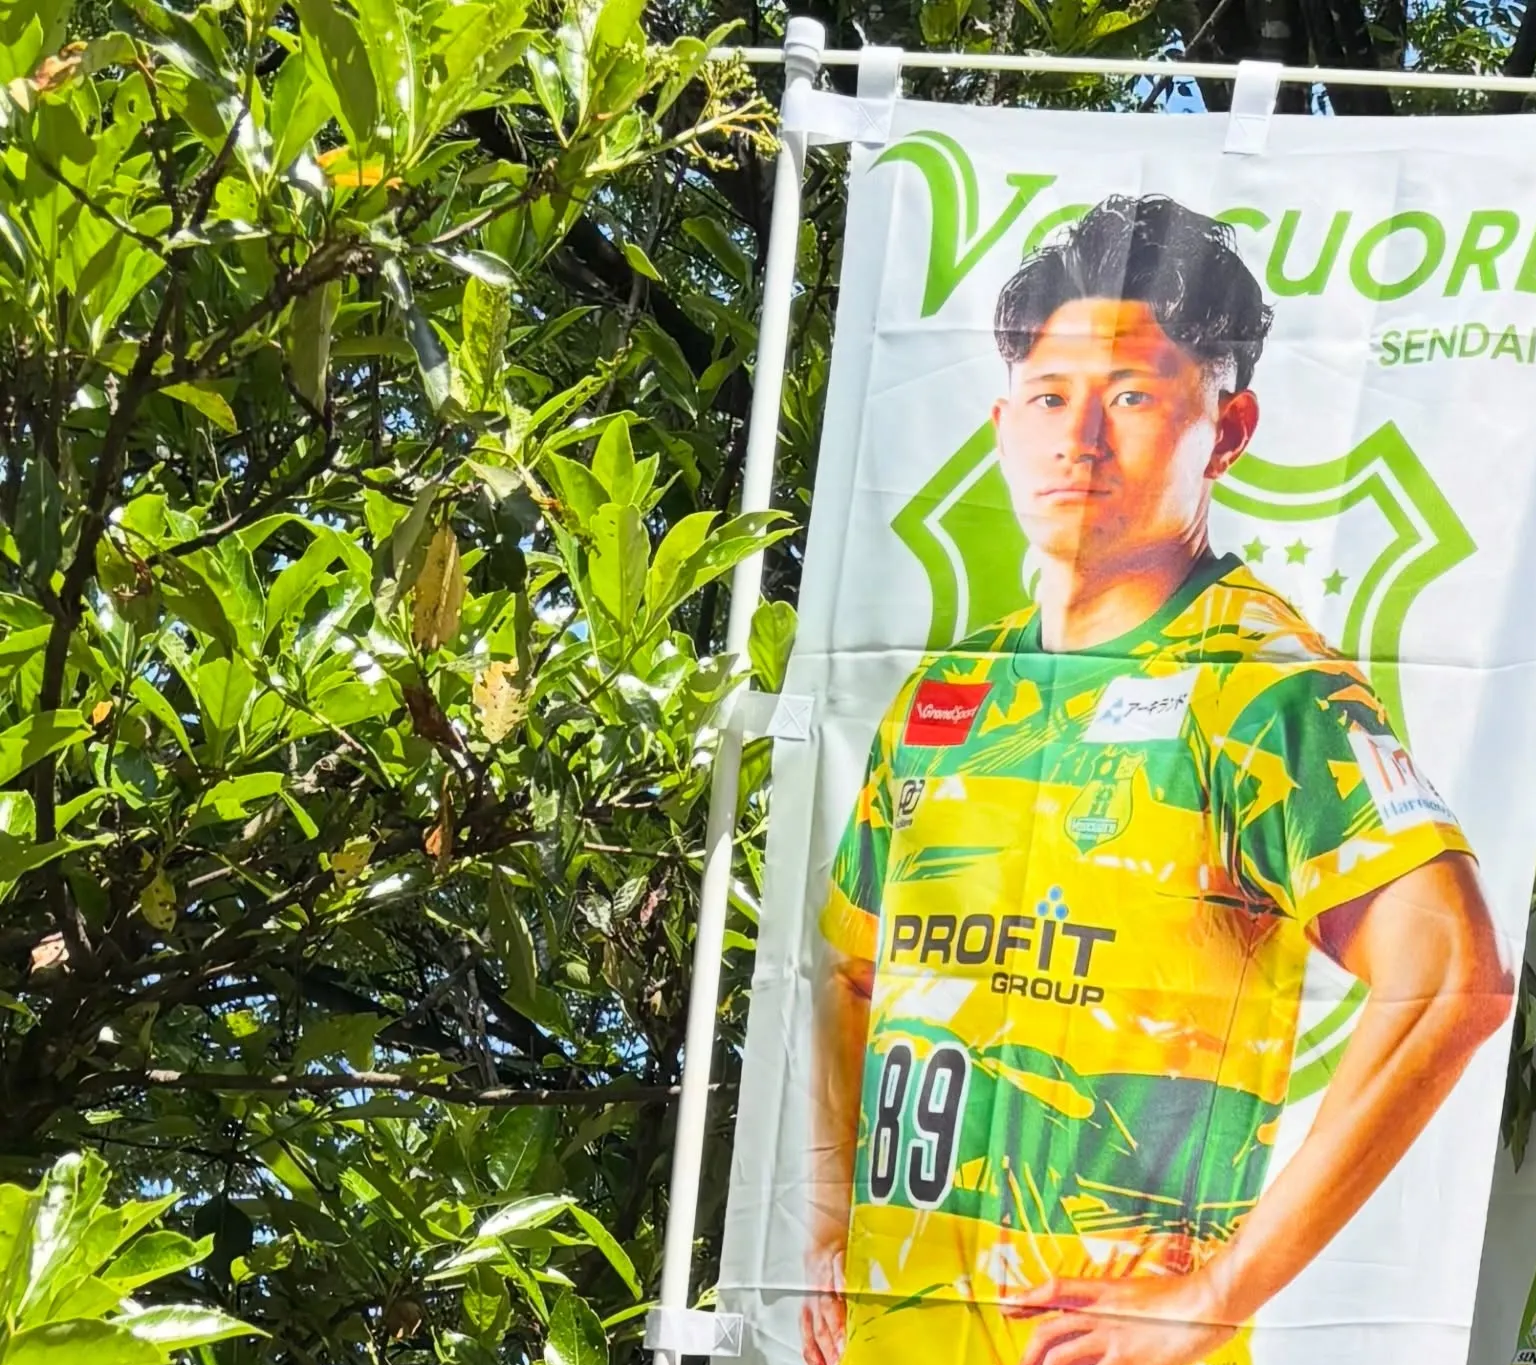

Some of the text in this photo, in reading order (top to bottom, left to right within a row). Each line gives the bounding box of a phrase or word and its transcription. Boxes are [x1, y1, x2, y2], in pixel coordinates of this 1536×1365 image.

[891, 913, 1117, 978] PROFIT
[990, 970, 1106, 1007] GROUP
[867, 1039, 974, 1211] 89
